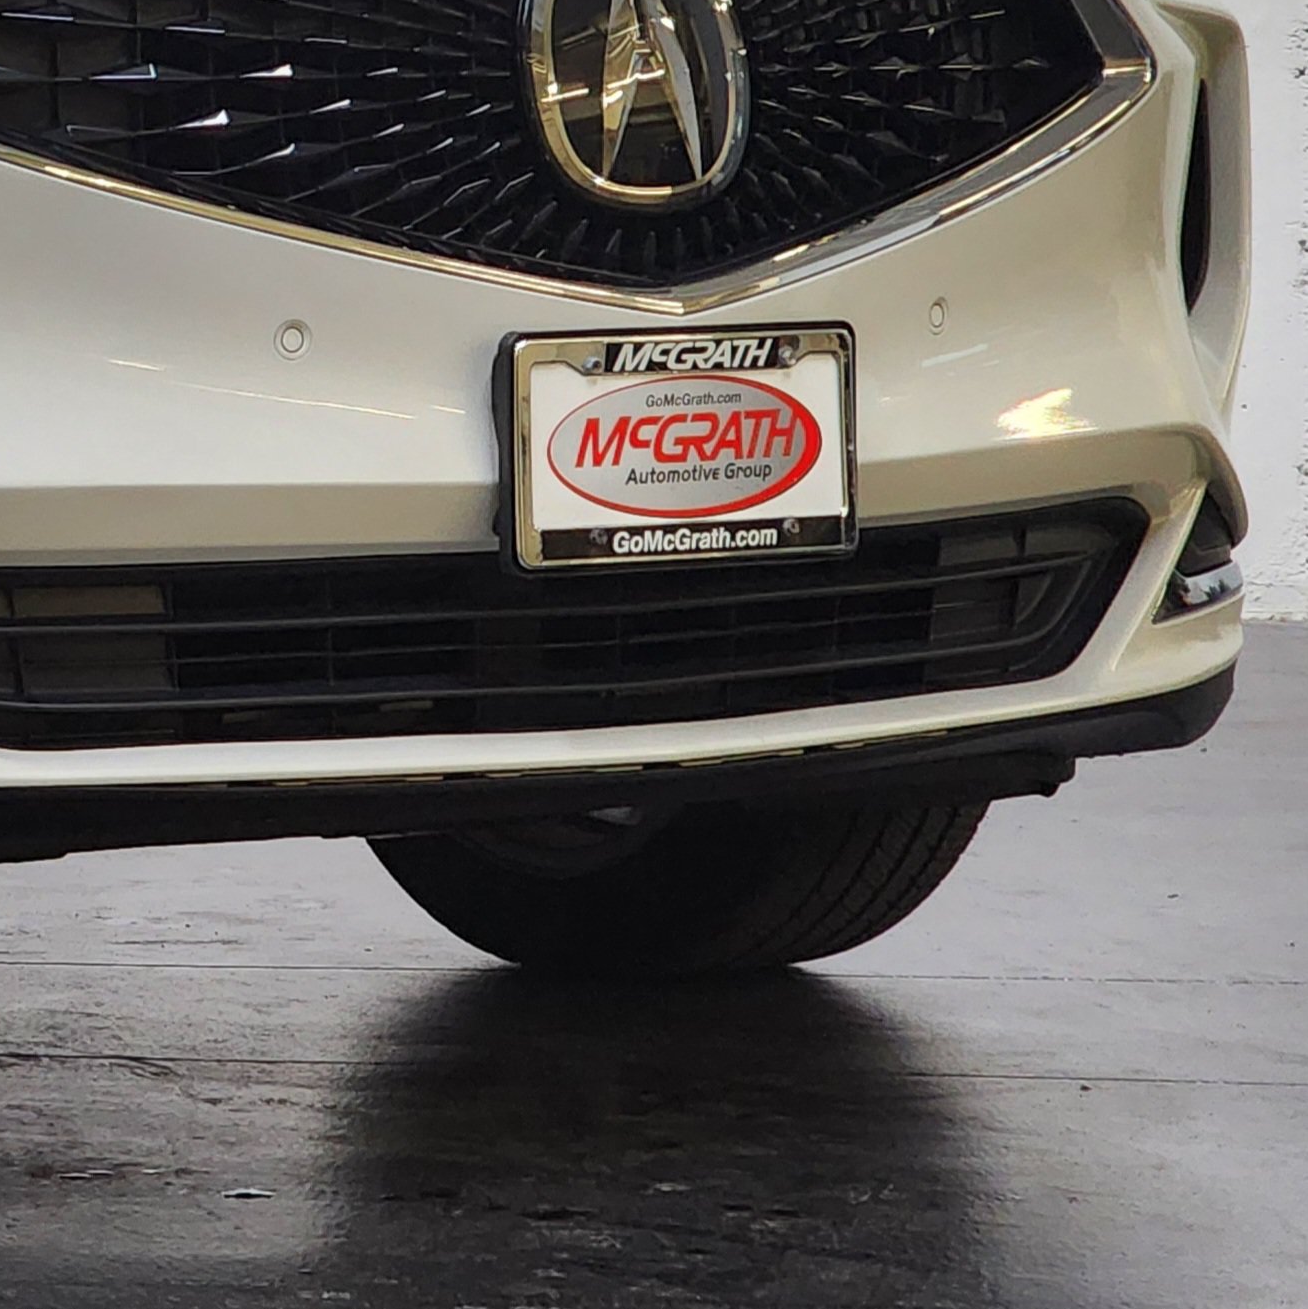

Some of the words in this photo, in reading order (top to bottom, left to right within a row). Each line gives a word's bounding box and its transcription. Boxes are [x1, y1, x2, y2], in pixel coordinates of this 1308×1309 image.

[645, 392, 742, 408] GoMcGrath.com
[625, 466, 721, 485] Automotive
[723, 462, 772, 482] Group
[612, 527, 778, 554] GoMcGrath.com
